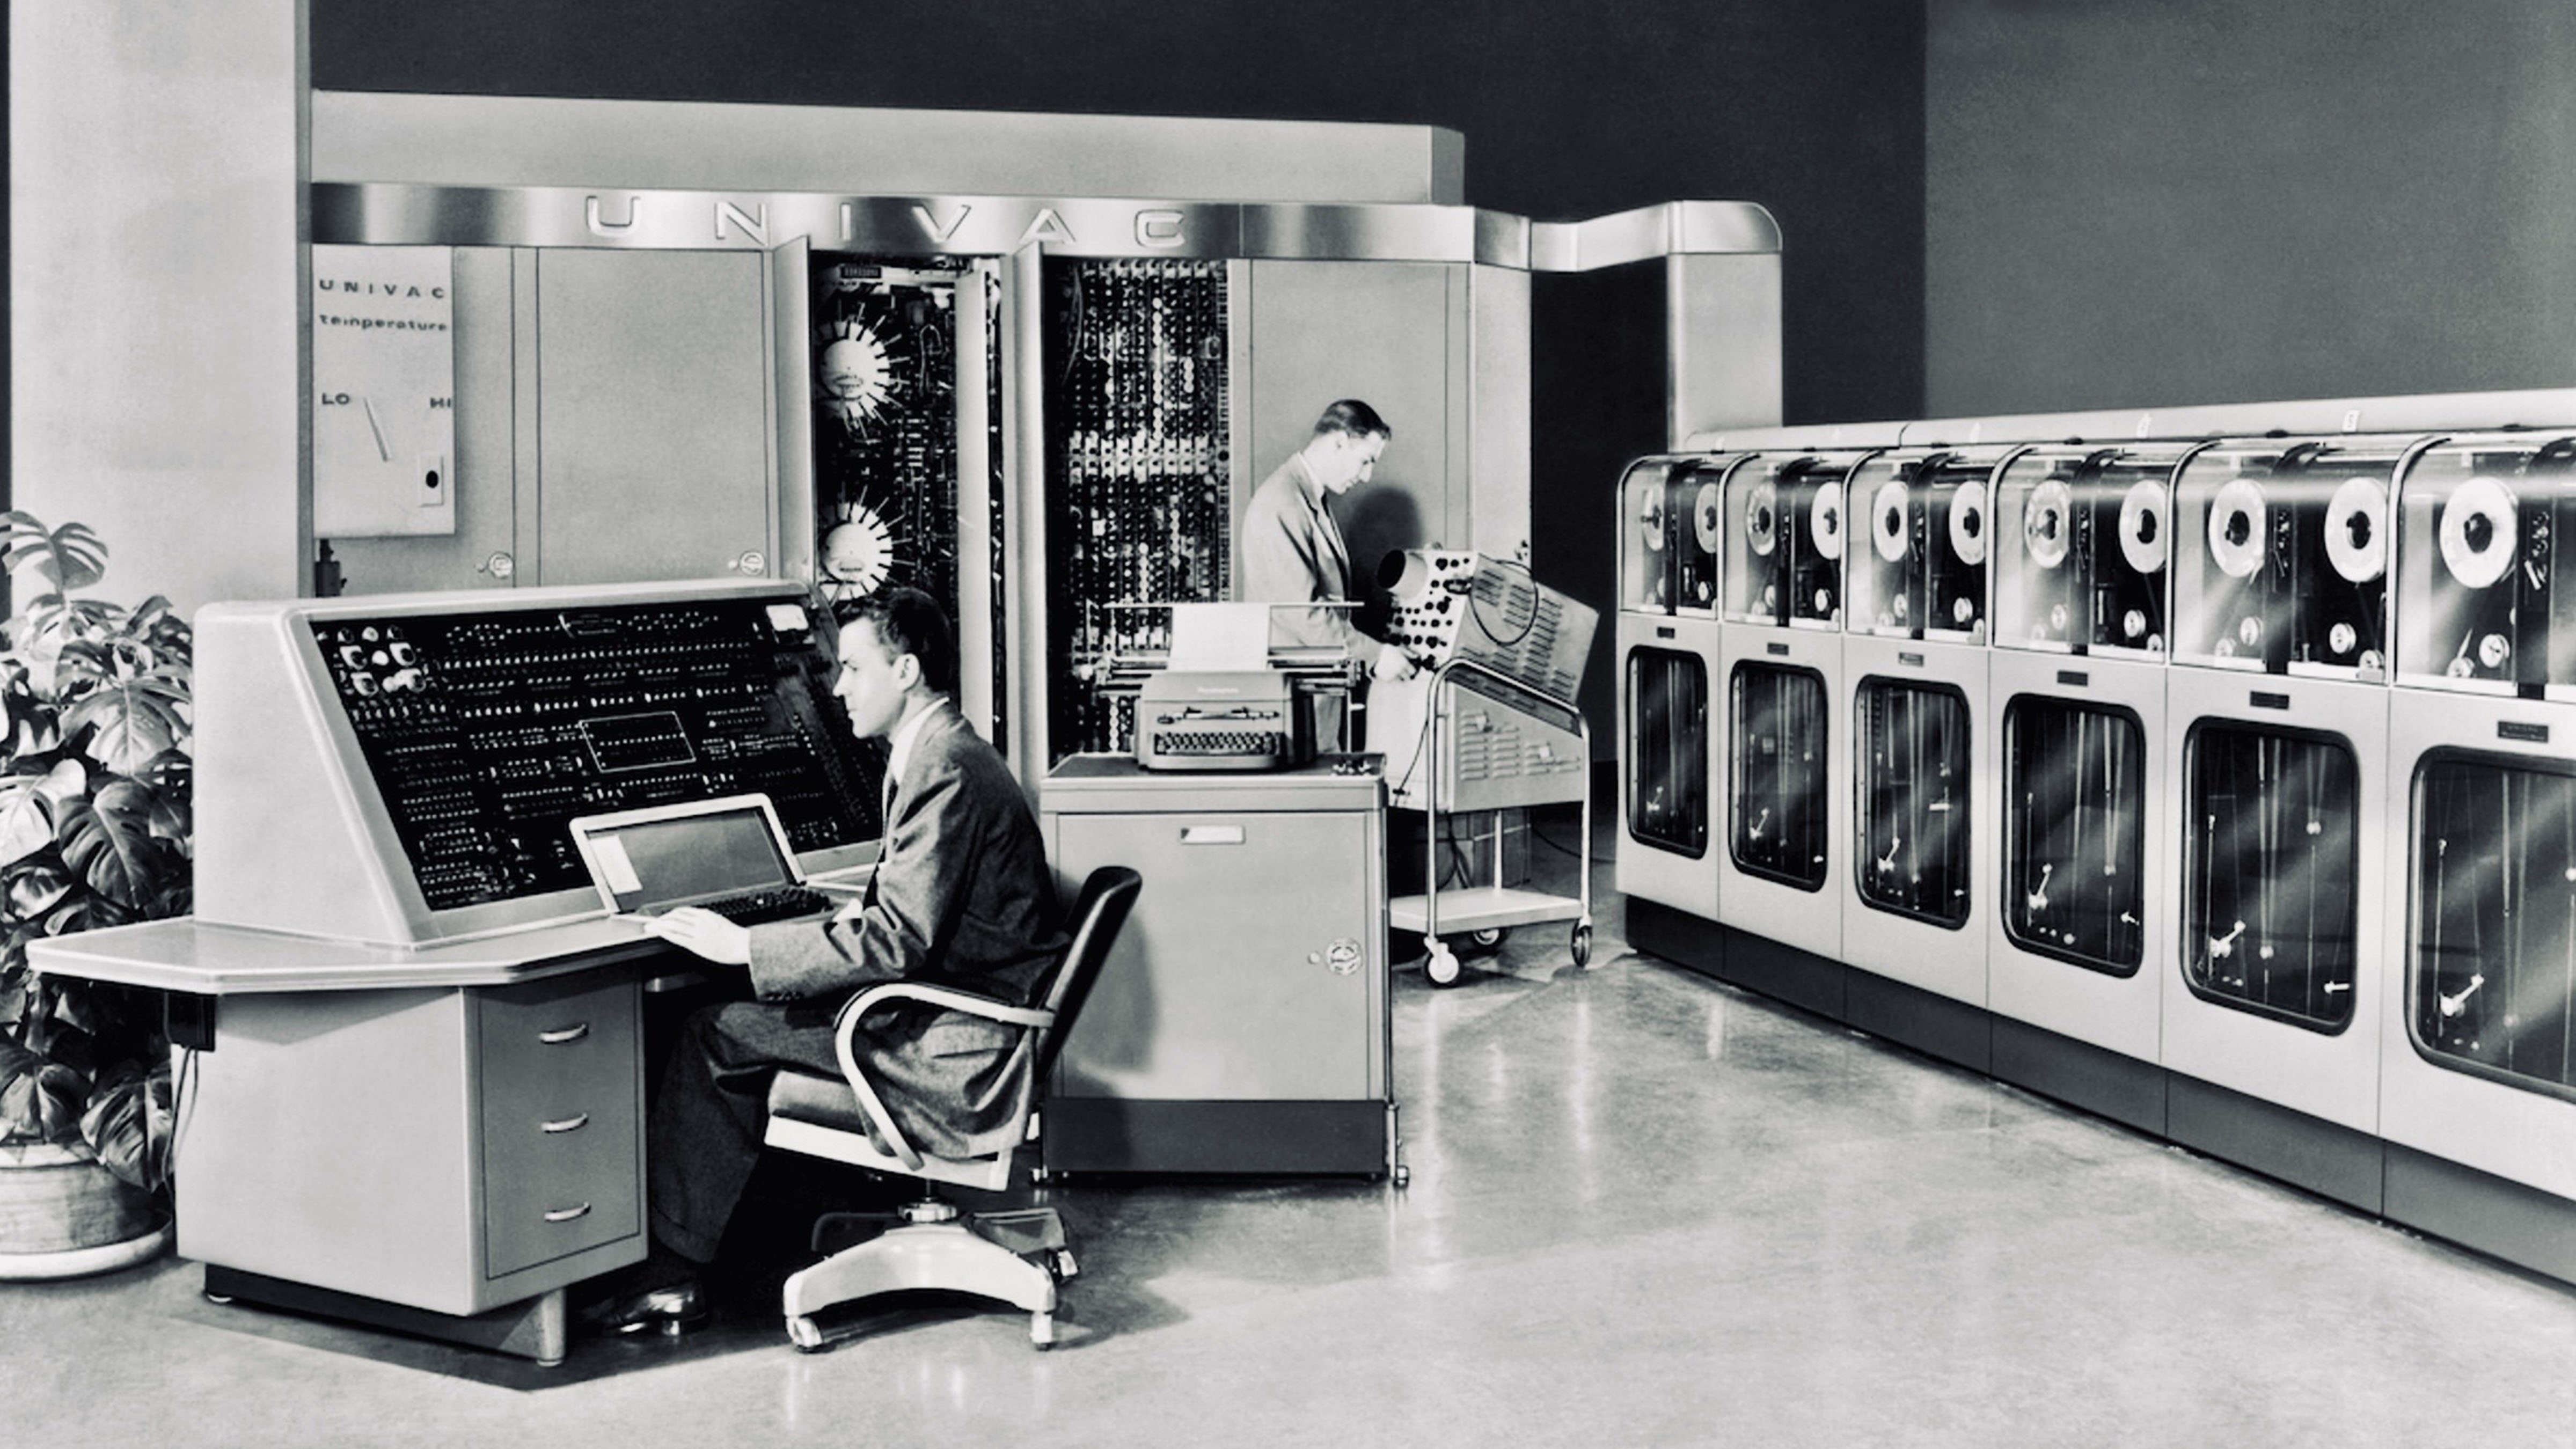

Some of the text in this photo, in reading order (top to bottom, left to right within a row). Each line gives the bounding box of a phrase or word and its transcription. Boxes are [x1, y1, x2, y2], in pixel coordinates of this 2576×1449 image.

[586, 195, 1185, 247] UNIVAC
[319, 280, 444, 298] UNIVAC
[322, 393, 451, 408] LO HI
